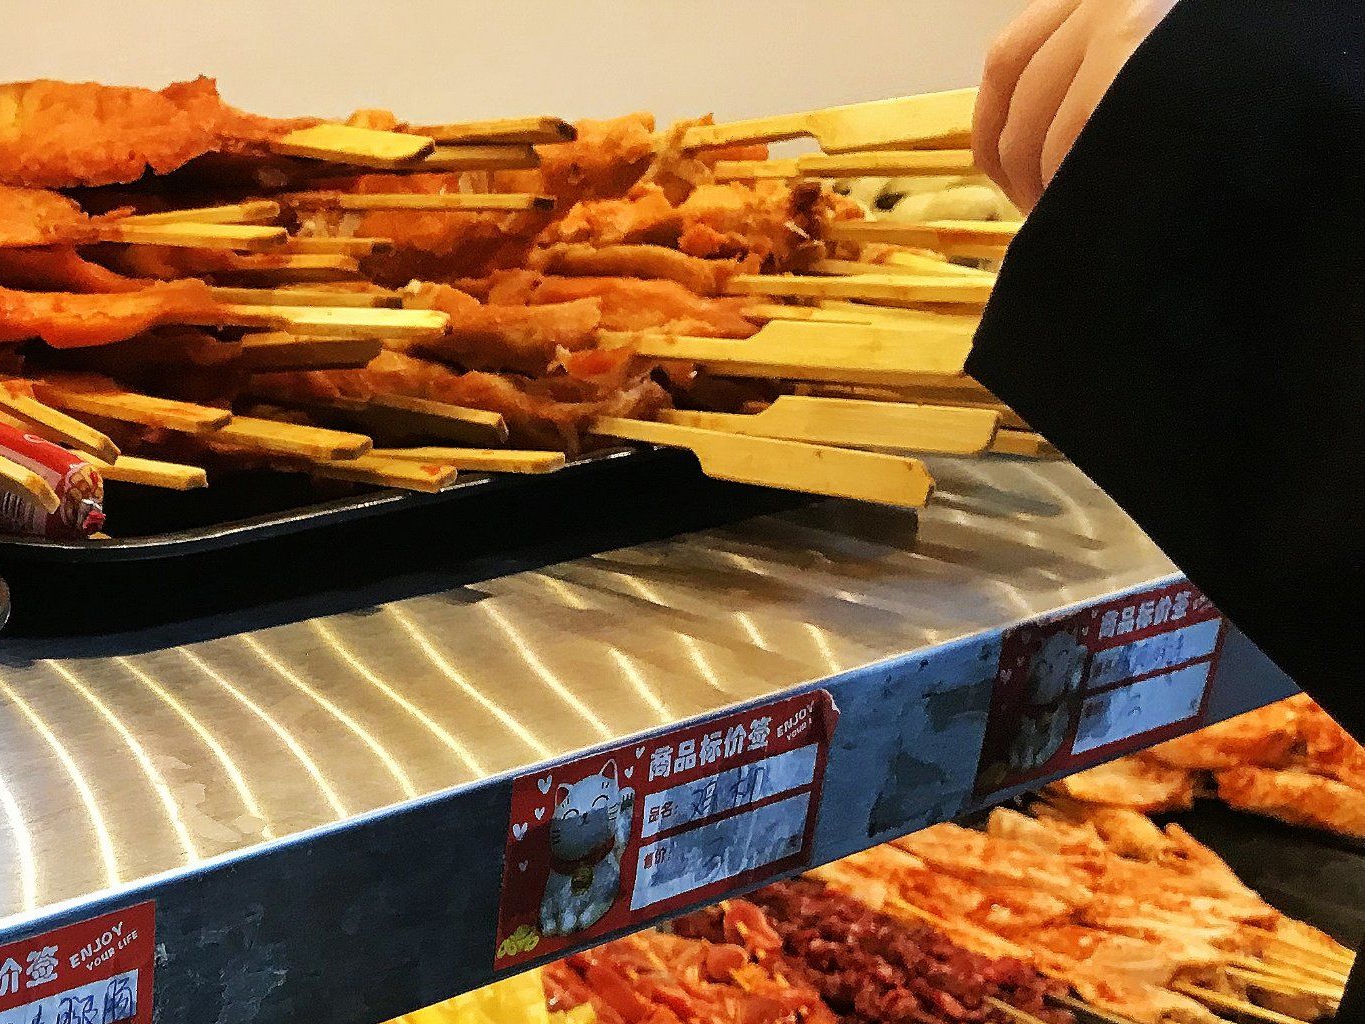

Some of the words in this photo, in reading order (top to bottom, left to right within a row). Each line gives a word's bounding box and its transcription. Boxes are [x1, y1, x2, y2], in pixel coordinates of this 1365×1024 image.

[776, 700, 815, 738] ENJOY
[648, 716, 773, 782] 商品标价签
[69, 921, 125, 969] ENJOY
[86, 948, 116, 972] YOUR
[118, 929, 139, 951] LIFE
